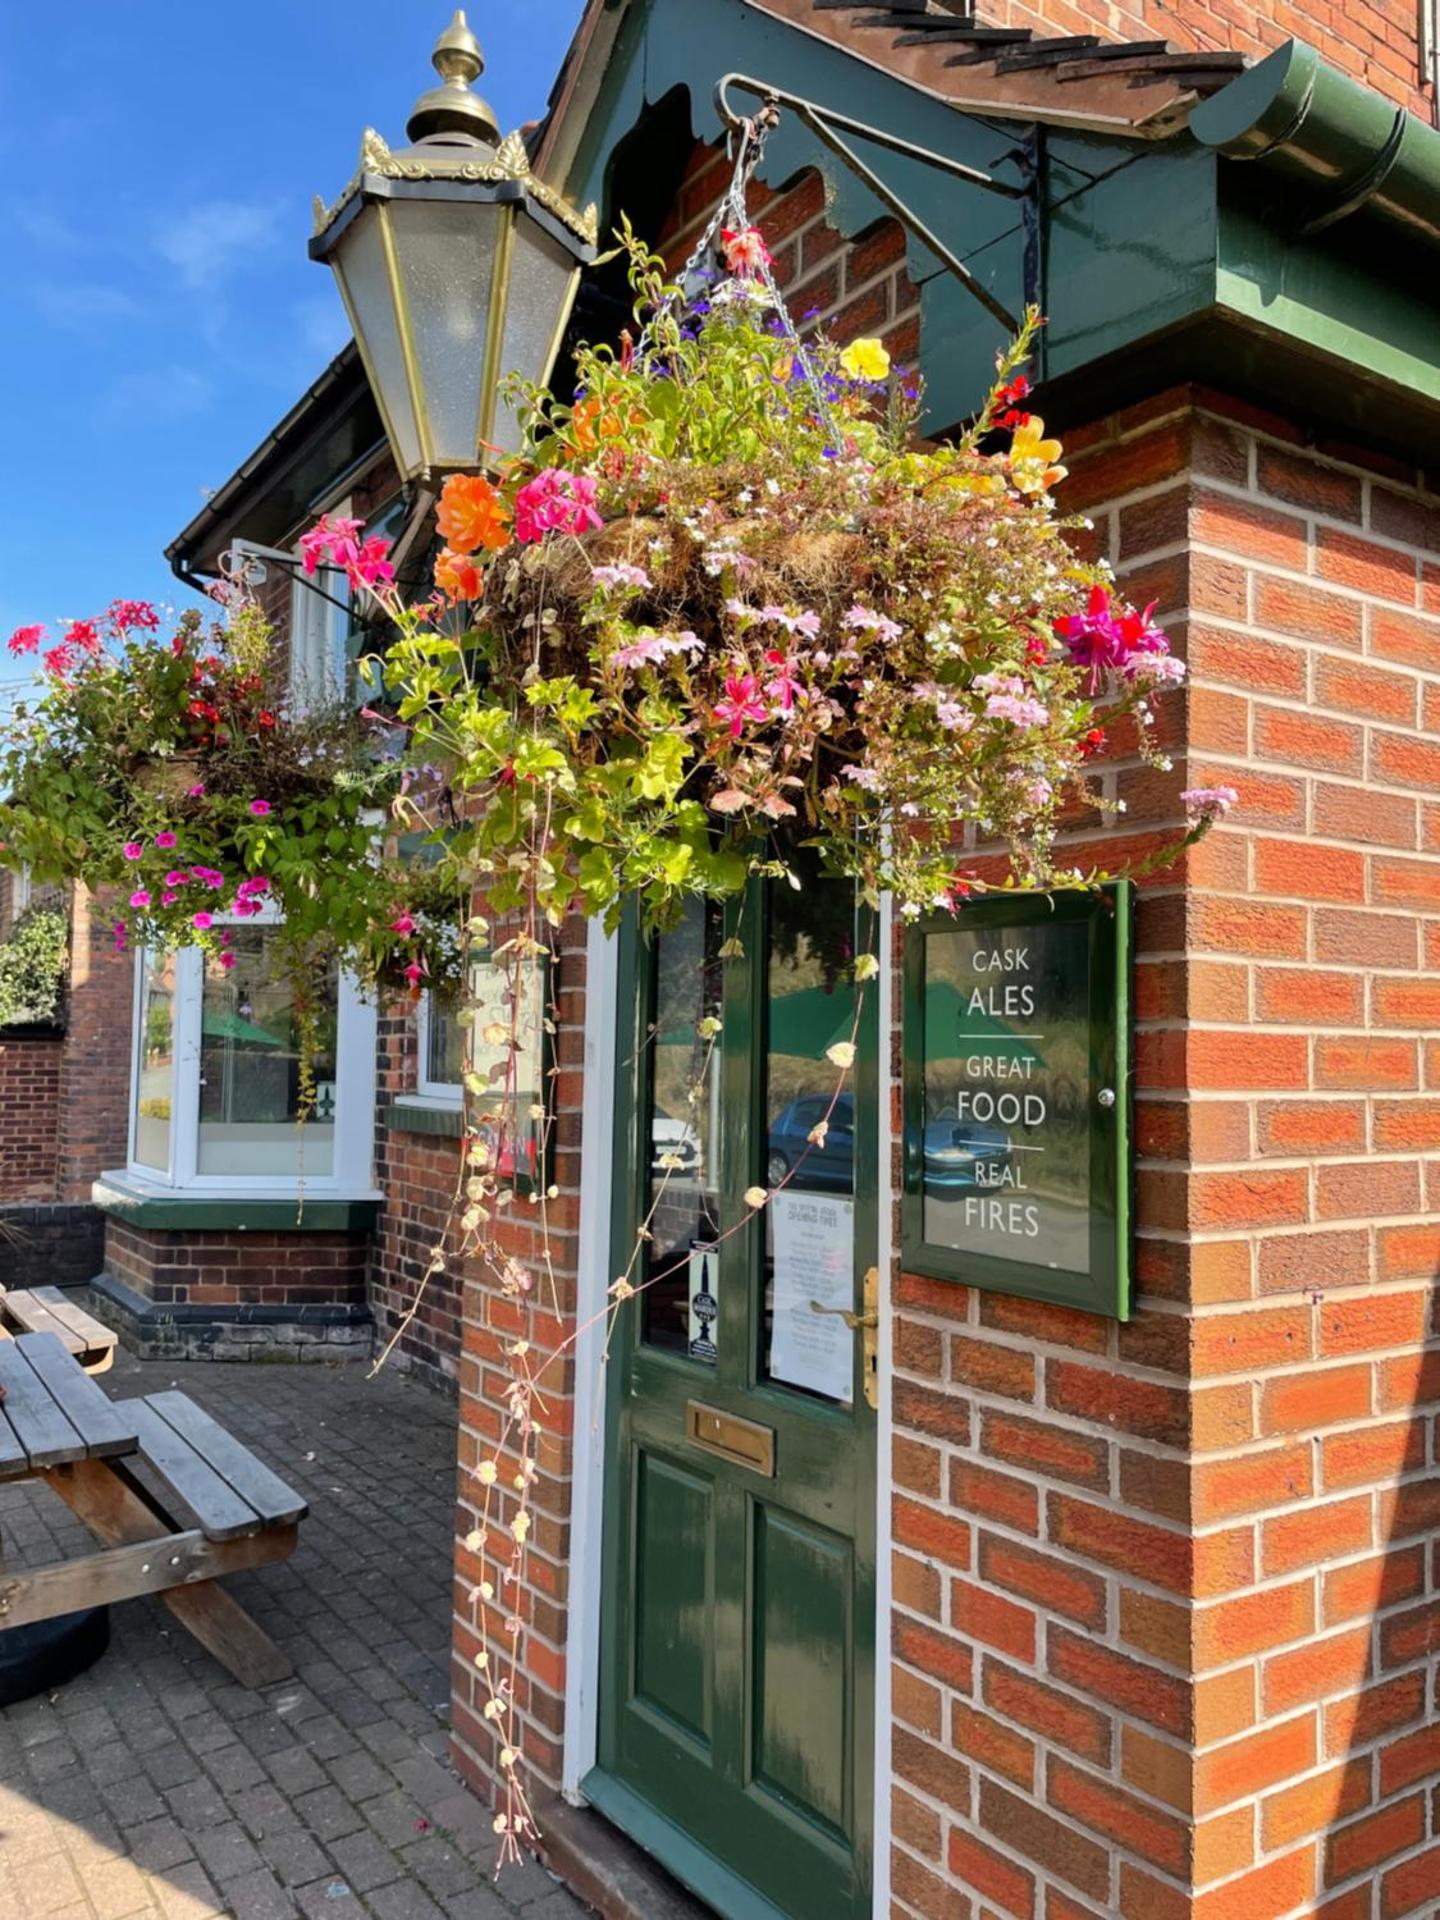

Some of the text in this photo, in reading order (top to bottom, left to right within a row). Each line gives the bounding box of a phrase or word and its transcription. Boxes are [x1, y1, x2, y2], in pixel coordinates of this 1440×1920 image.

[972, 948, 1030, 972] CASK
[967, 985, 1035, 1017] ALES
[966, 1055, 1036, 1080] GREAT
[958, 1091, 1046, 1126] FOOD
[974, 1161, 1028, 1189] REAL
[964, 1197, 1039, 1238] FIRES
